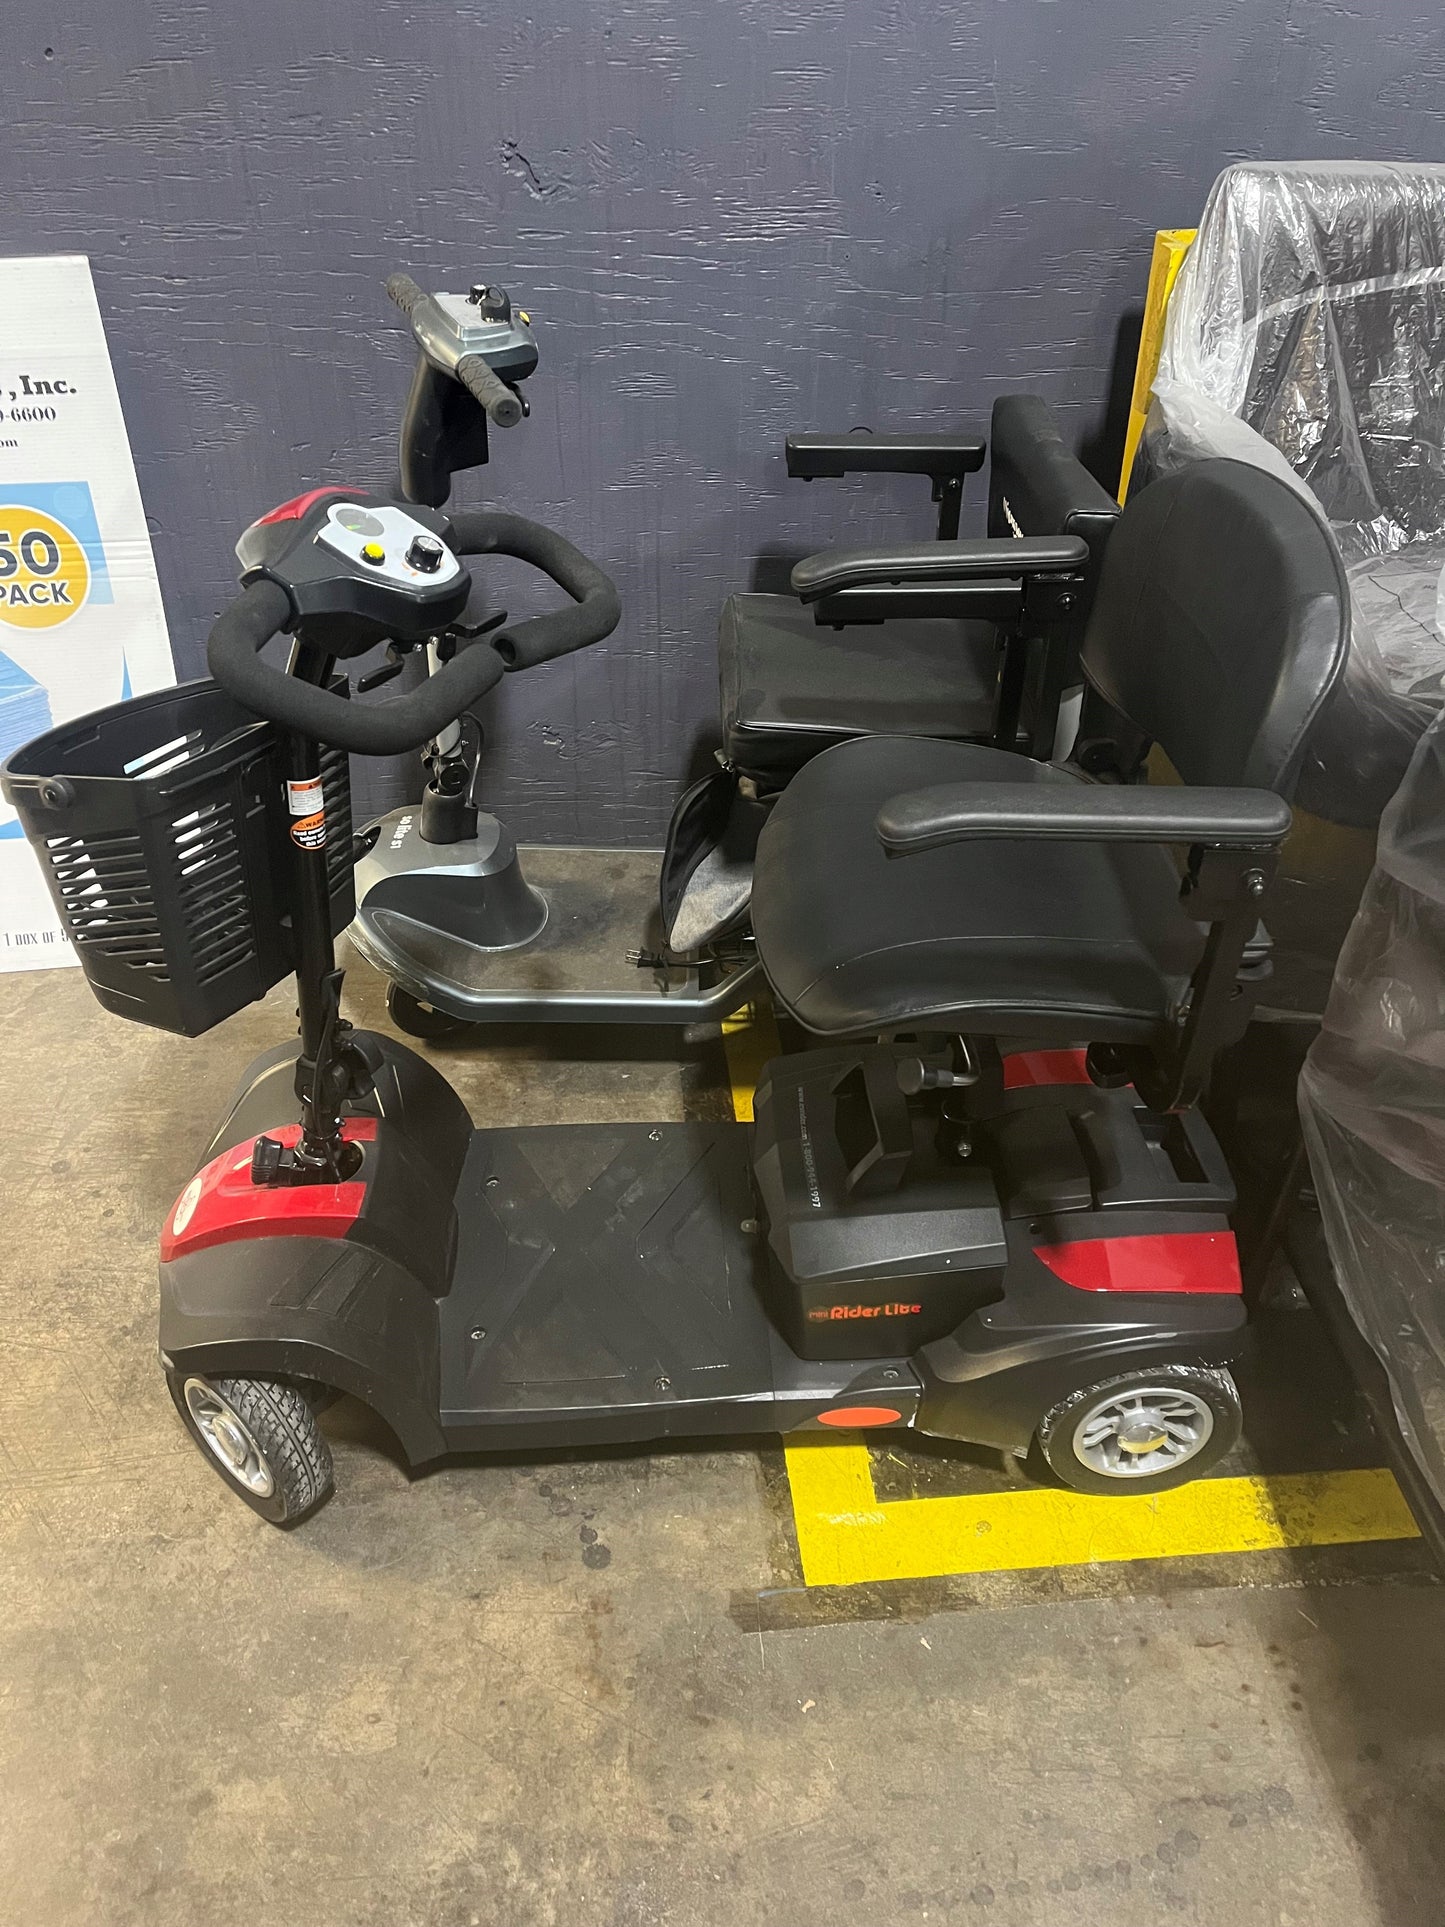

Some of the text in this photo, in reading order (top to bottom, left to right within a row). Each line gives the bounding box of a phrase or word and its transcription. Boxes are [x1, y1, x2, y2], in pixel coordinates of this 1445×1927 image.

[3, 932, 10, 947] 1
[42, 931, 57, 944] OF
[830, 1304, 881, 1320] Rider
